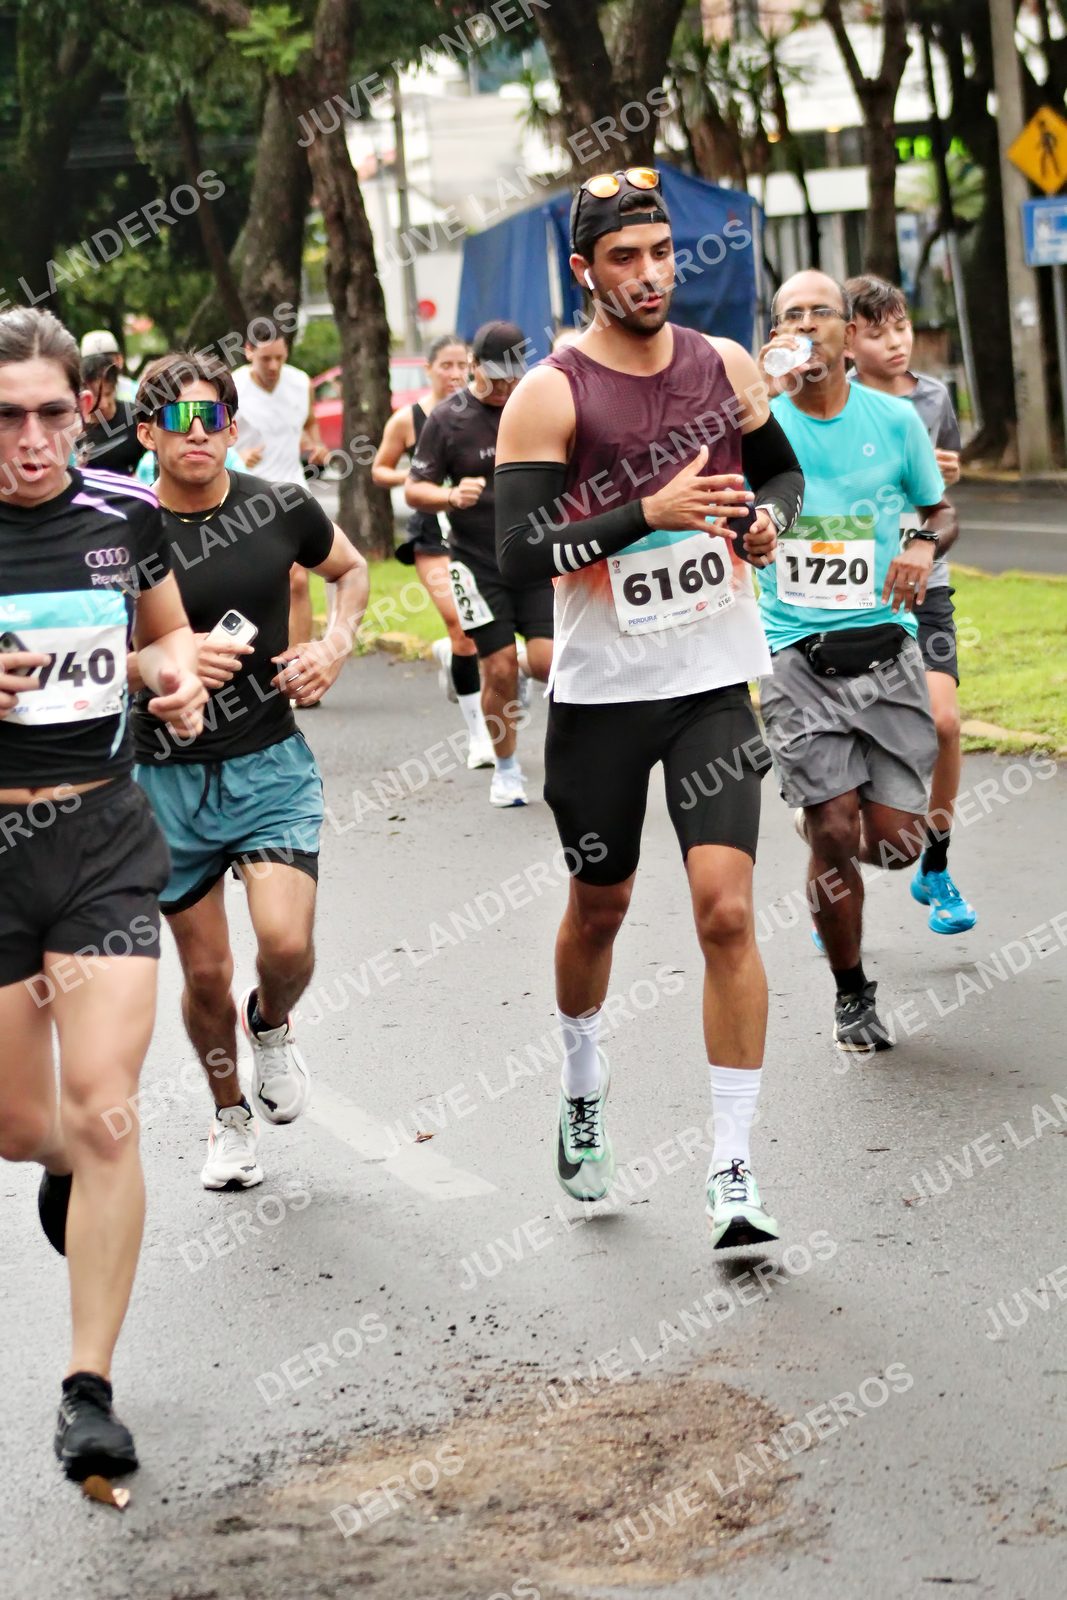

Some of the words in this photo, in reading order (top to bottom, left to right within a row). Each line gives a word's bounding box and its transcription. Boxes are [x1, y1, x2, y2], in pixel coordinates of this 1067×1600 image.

[623, 552, 725, 606] 6160
[786, 556, 868, 585] 1720
[26, 648, 115, 690] 740
